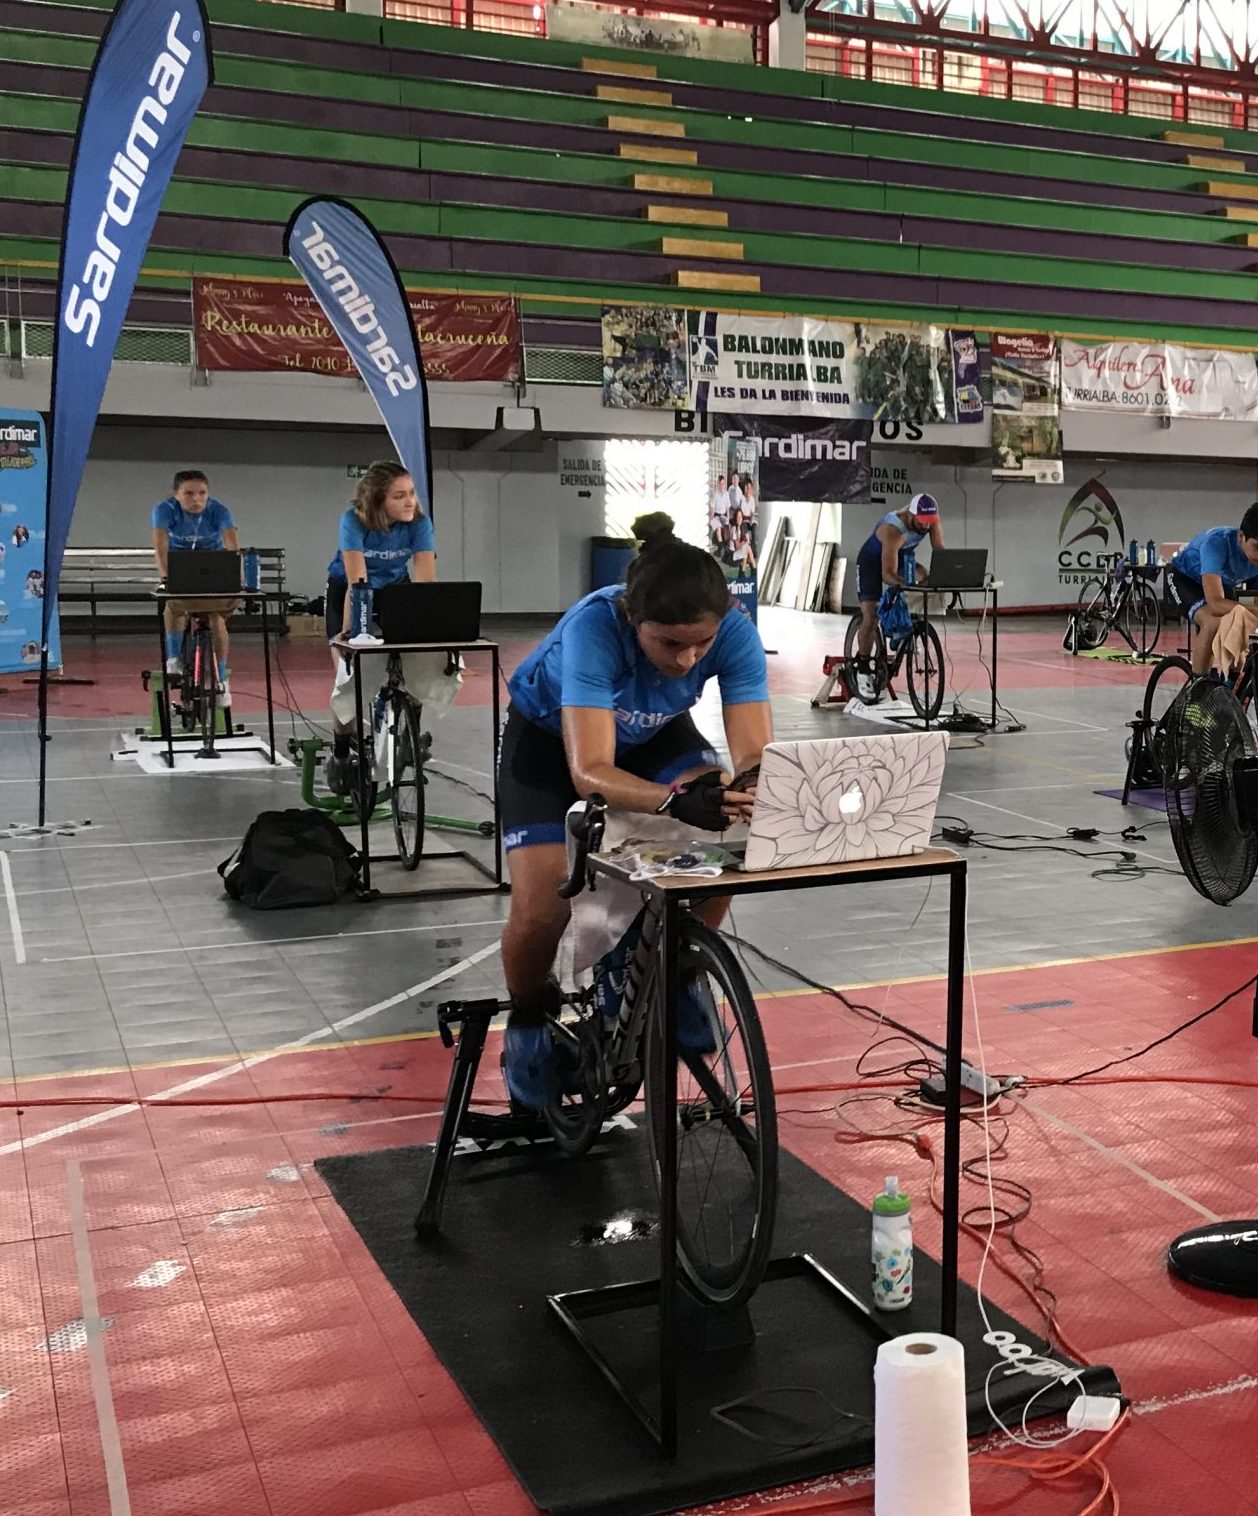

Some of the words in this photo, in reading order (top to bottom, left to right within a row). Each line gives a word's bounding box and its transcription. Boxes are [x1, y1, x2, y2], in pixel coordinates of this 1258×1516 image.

[64, 11, 192, 347] Sardimar
[201, 310, 335, 338] Restaurante
[416, 324, 509, 346] tacruceña
[722, 334, 845, 360] BALONMANO
[734, 360, 843, 384] TURRIALBA
[714, 386, 736, 399] LES
[740, 387, 758, 400] DA
[762, 388, 777, 401] LA
[781, 390, 850, 405] BIENVENIDA
[0, 425, 38, 442] rdimar
[563, 459, 590, 471] SALIDA
[591, 459, 602, 471] DE
[893, 468, 908, 480] DE
[560, 474, 605, 486] EMERGENCIA
[872, 482, 913, 495] GENCIA
[360, 602, 368, 634] ardimar
